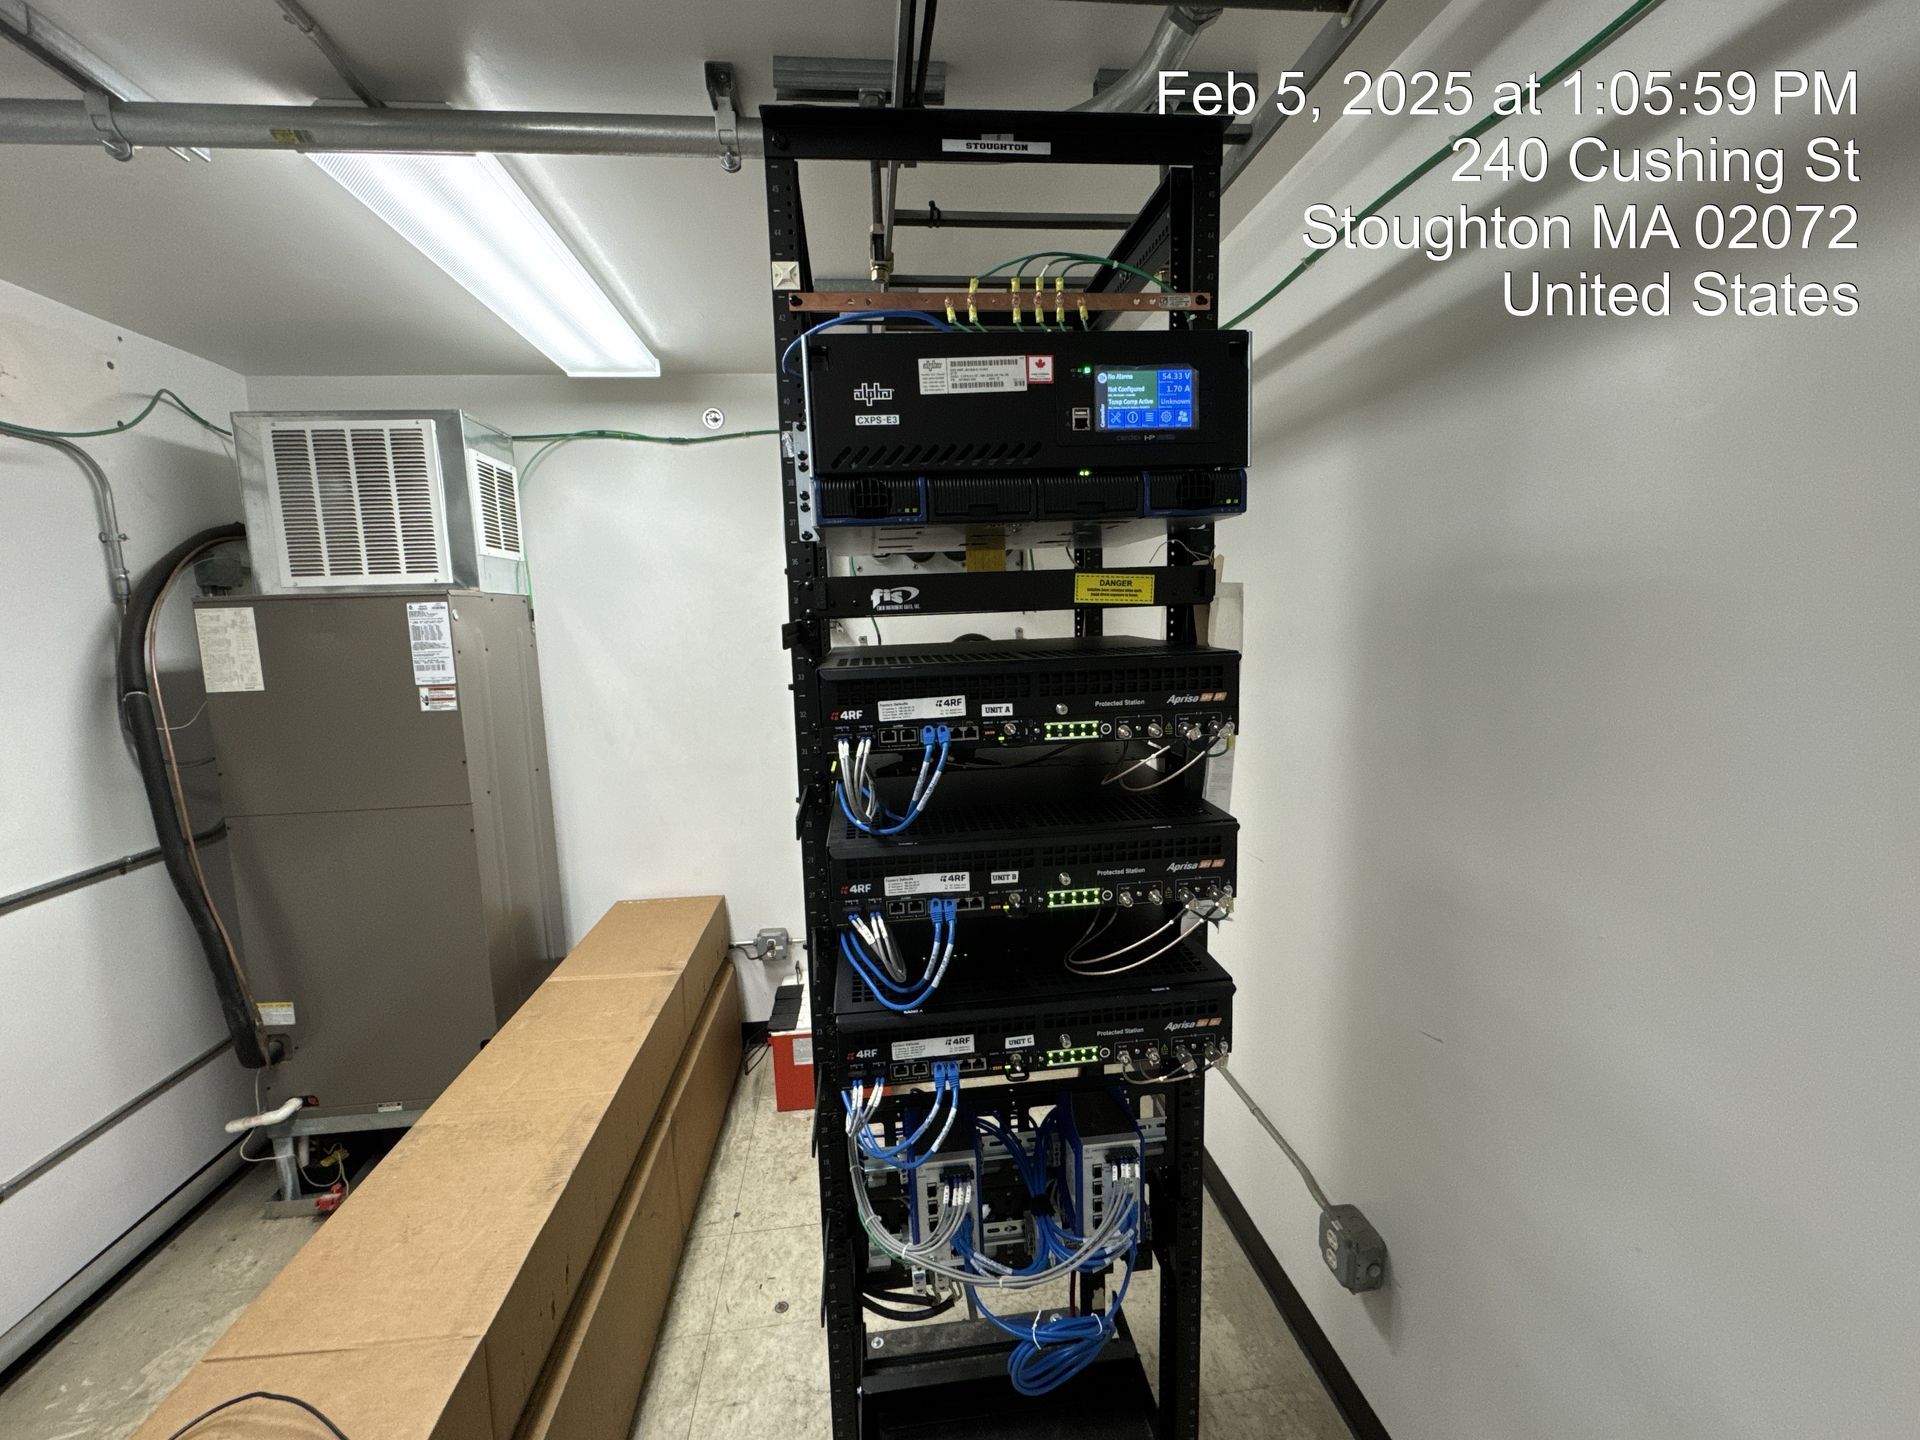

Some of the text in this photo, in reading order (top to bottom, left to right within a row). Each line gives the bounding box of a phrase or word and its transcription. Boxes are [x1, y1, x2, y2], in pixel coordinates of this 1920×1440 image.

[965, 142, 1029, 152] STOUGHTON
[1184, 372, 1191, 380] V
[1166, 385, 1183, 393] 1.70
[856, 415, 899, 425] CXPS-E3
[1099, 579, 1133, 587] DANGER
[943, 698, 963, 707] 4RF
[1166, 694, 1199, 705] Aprisa
[984, 706, 1003, 714] UNIT
[839, 710, 864, 721] 4RF
[1166, 862, 1198, 872] Aprisa
[947, 874, 966, 882] 4RF
[992, 874, 1009, 882] UNIT
[849, 884, 872, 894] 4RF
[1164, 1020, 1196, 1032] Aprisa
[1096, 1029, 1124, 1037] Protected
[952, 1036, 971, 1045] 4RF
[1008, 1039, 1026, 1047] UNIT
[855, 1048, 878, 1059] 4RF
